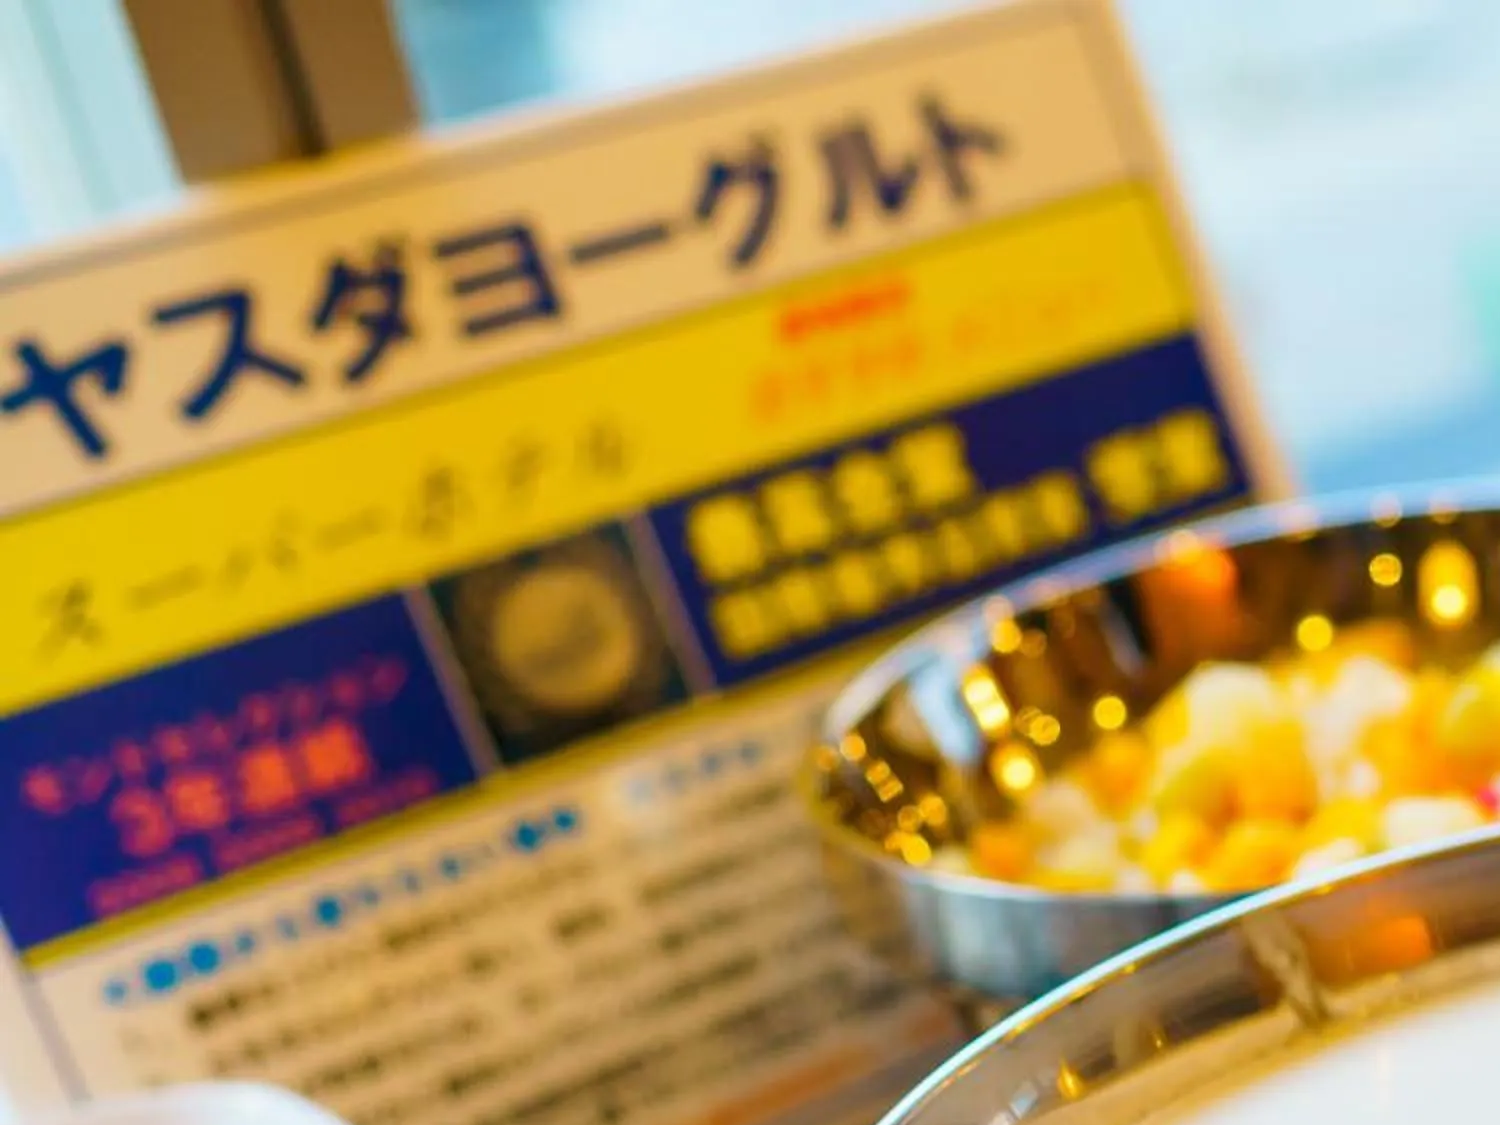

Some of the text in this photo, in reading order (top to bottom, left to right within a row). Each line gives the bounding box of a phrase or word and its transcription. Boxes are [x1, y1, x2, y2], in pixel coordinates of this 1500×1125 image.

[0, 90, 1008, 457] ヤスダヨーグルト
